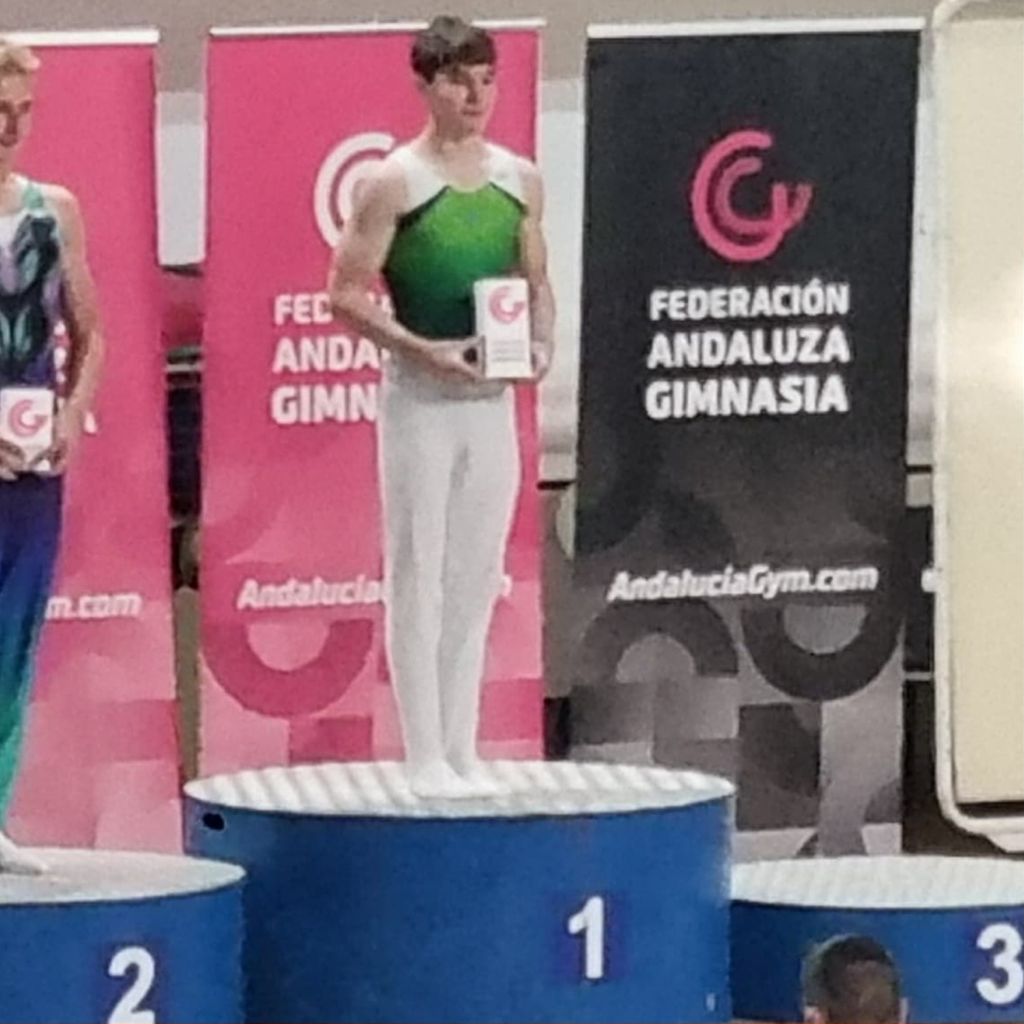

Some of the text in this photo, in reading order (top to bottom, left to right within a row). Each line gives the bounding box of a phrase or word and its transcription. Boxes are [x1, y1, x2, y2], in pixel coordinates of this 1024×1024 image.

[650, 277, 849, 321] FEDERACIÓN
[647, 325, 850, 369] ANDALUZA
[645, 373, 849, 420] GIMNASIA
[607, 563, 878, 601] AndaluciaGym.com
[567, 895, 604, 979] 1
[108, 946, 155, 1024] 2
[976, 923, 1024, 1005] 3
